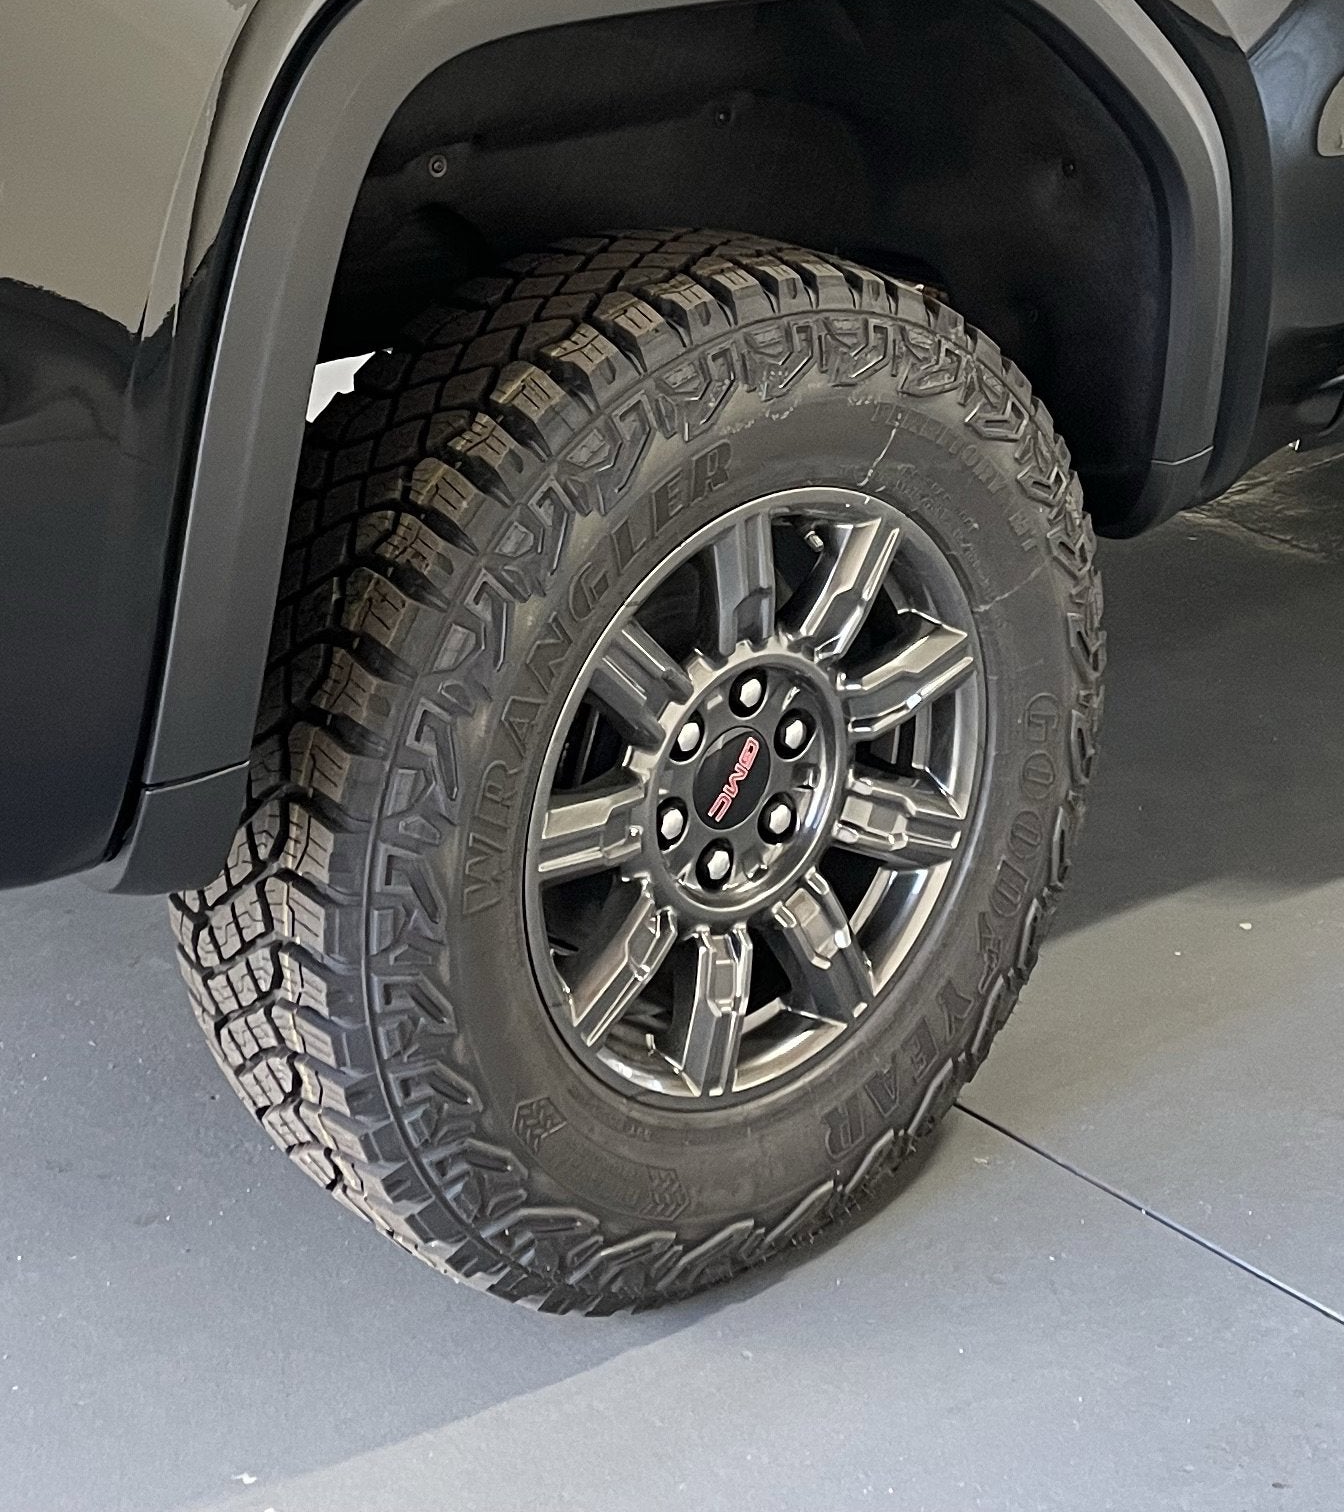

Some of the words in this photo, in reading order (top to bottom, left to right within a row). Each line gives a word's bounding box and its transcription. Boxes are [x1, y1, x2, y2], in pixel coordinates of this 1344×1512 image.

[462, 439, 733, 915] WRANGLER
[707, 736, 760, 823] GMC
[822, 692, 1058, 1162] GOODYEAR
